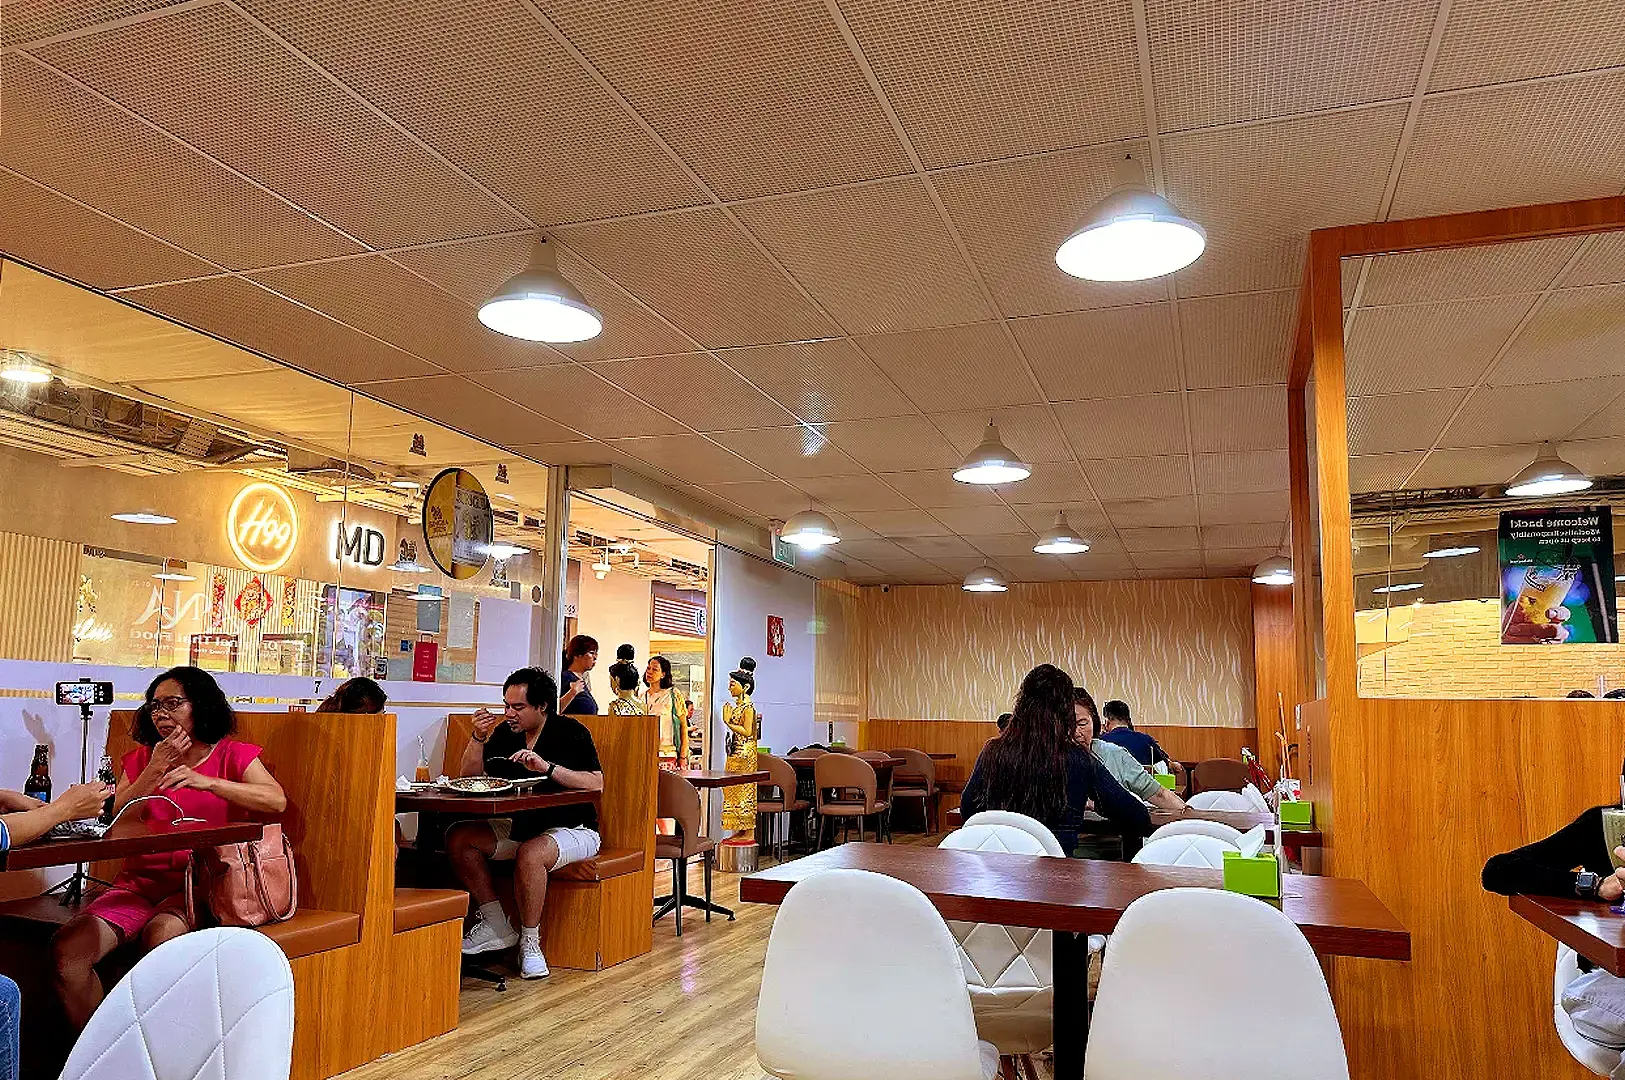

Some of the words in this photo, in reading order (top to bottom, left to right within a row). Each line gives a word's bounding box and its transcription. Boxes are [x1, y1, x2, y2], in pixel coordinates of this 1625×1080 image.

[238, 497, 291, 549] H99
[335, 521, 385, 566] MD
[314, 680, 322, 694] 7
